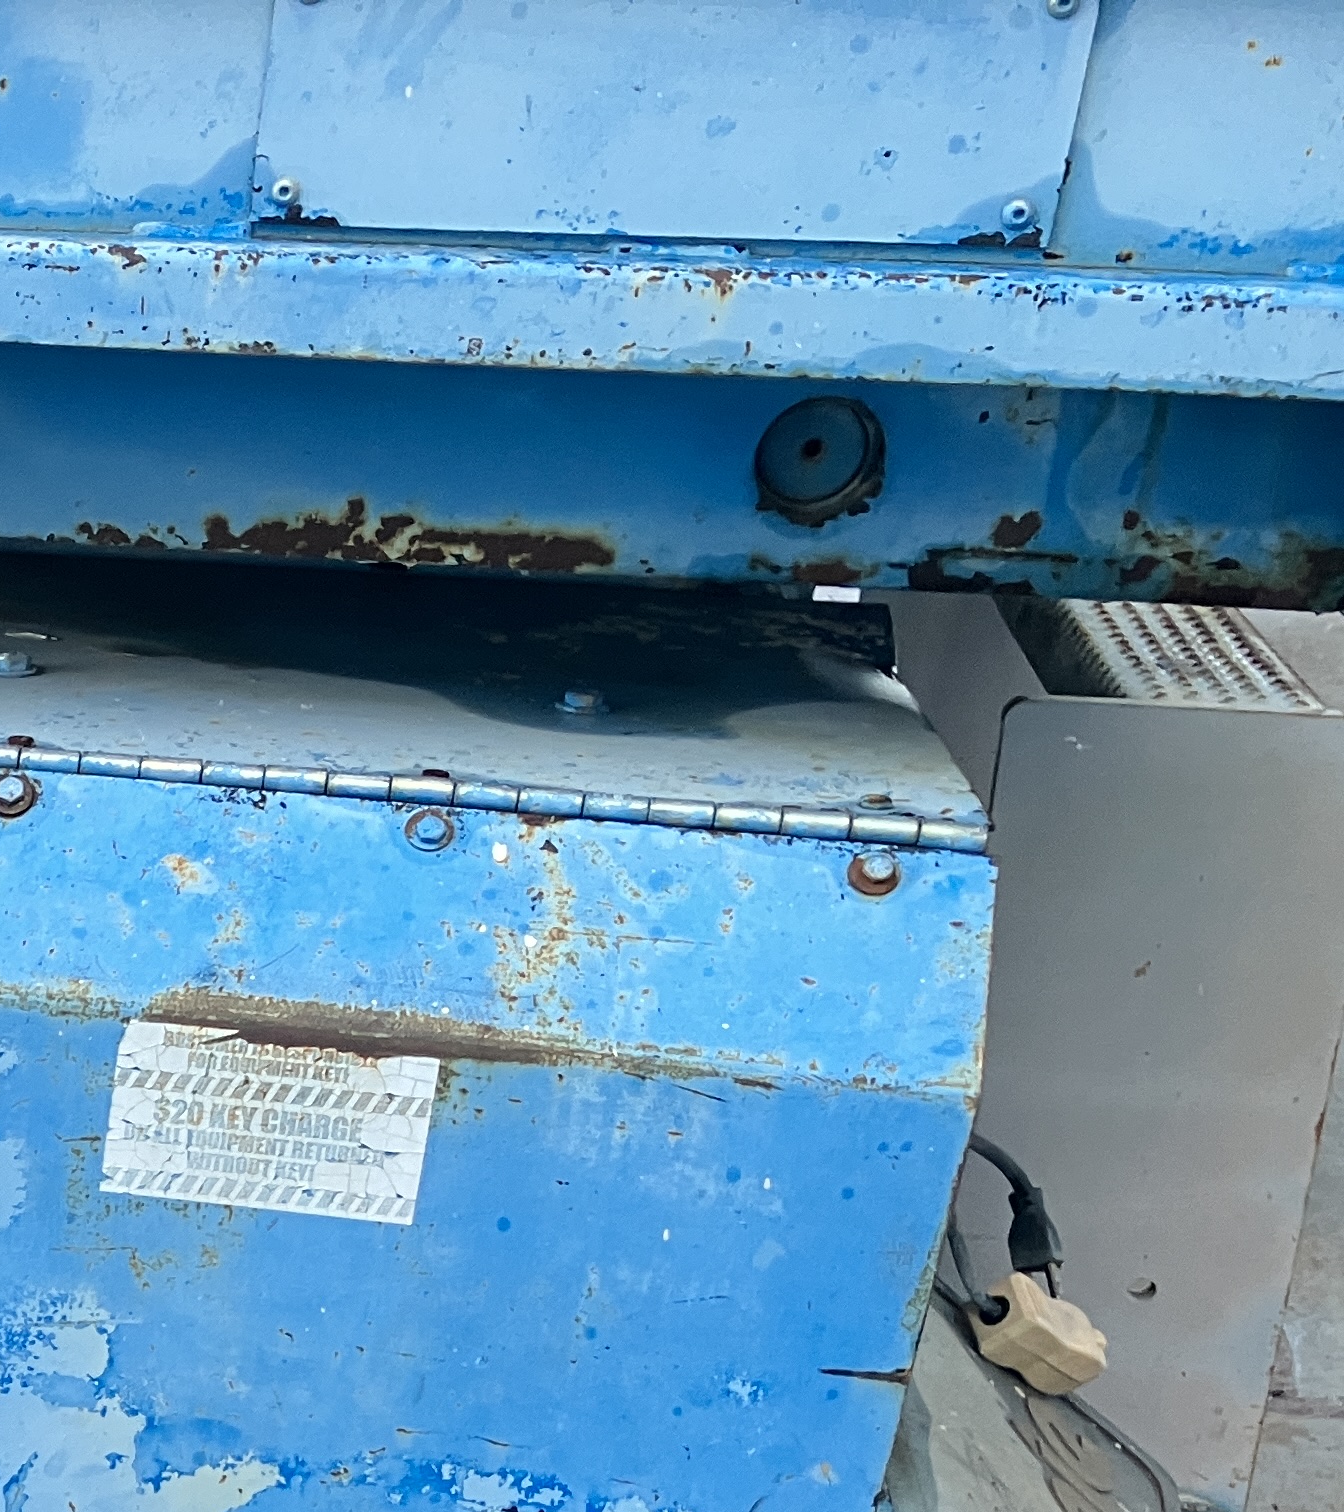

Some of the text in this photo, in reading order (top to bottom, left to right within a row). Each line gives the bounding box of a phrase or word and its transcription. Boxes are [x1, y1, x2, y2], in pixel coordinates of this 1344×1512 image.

[153, 1095, 364, 1144] $20 KEY CHARGE
